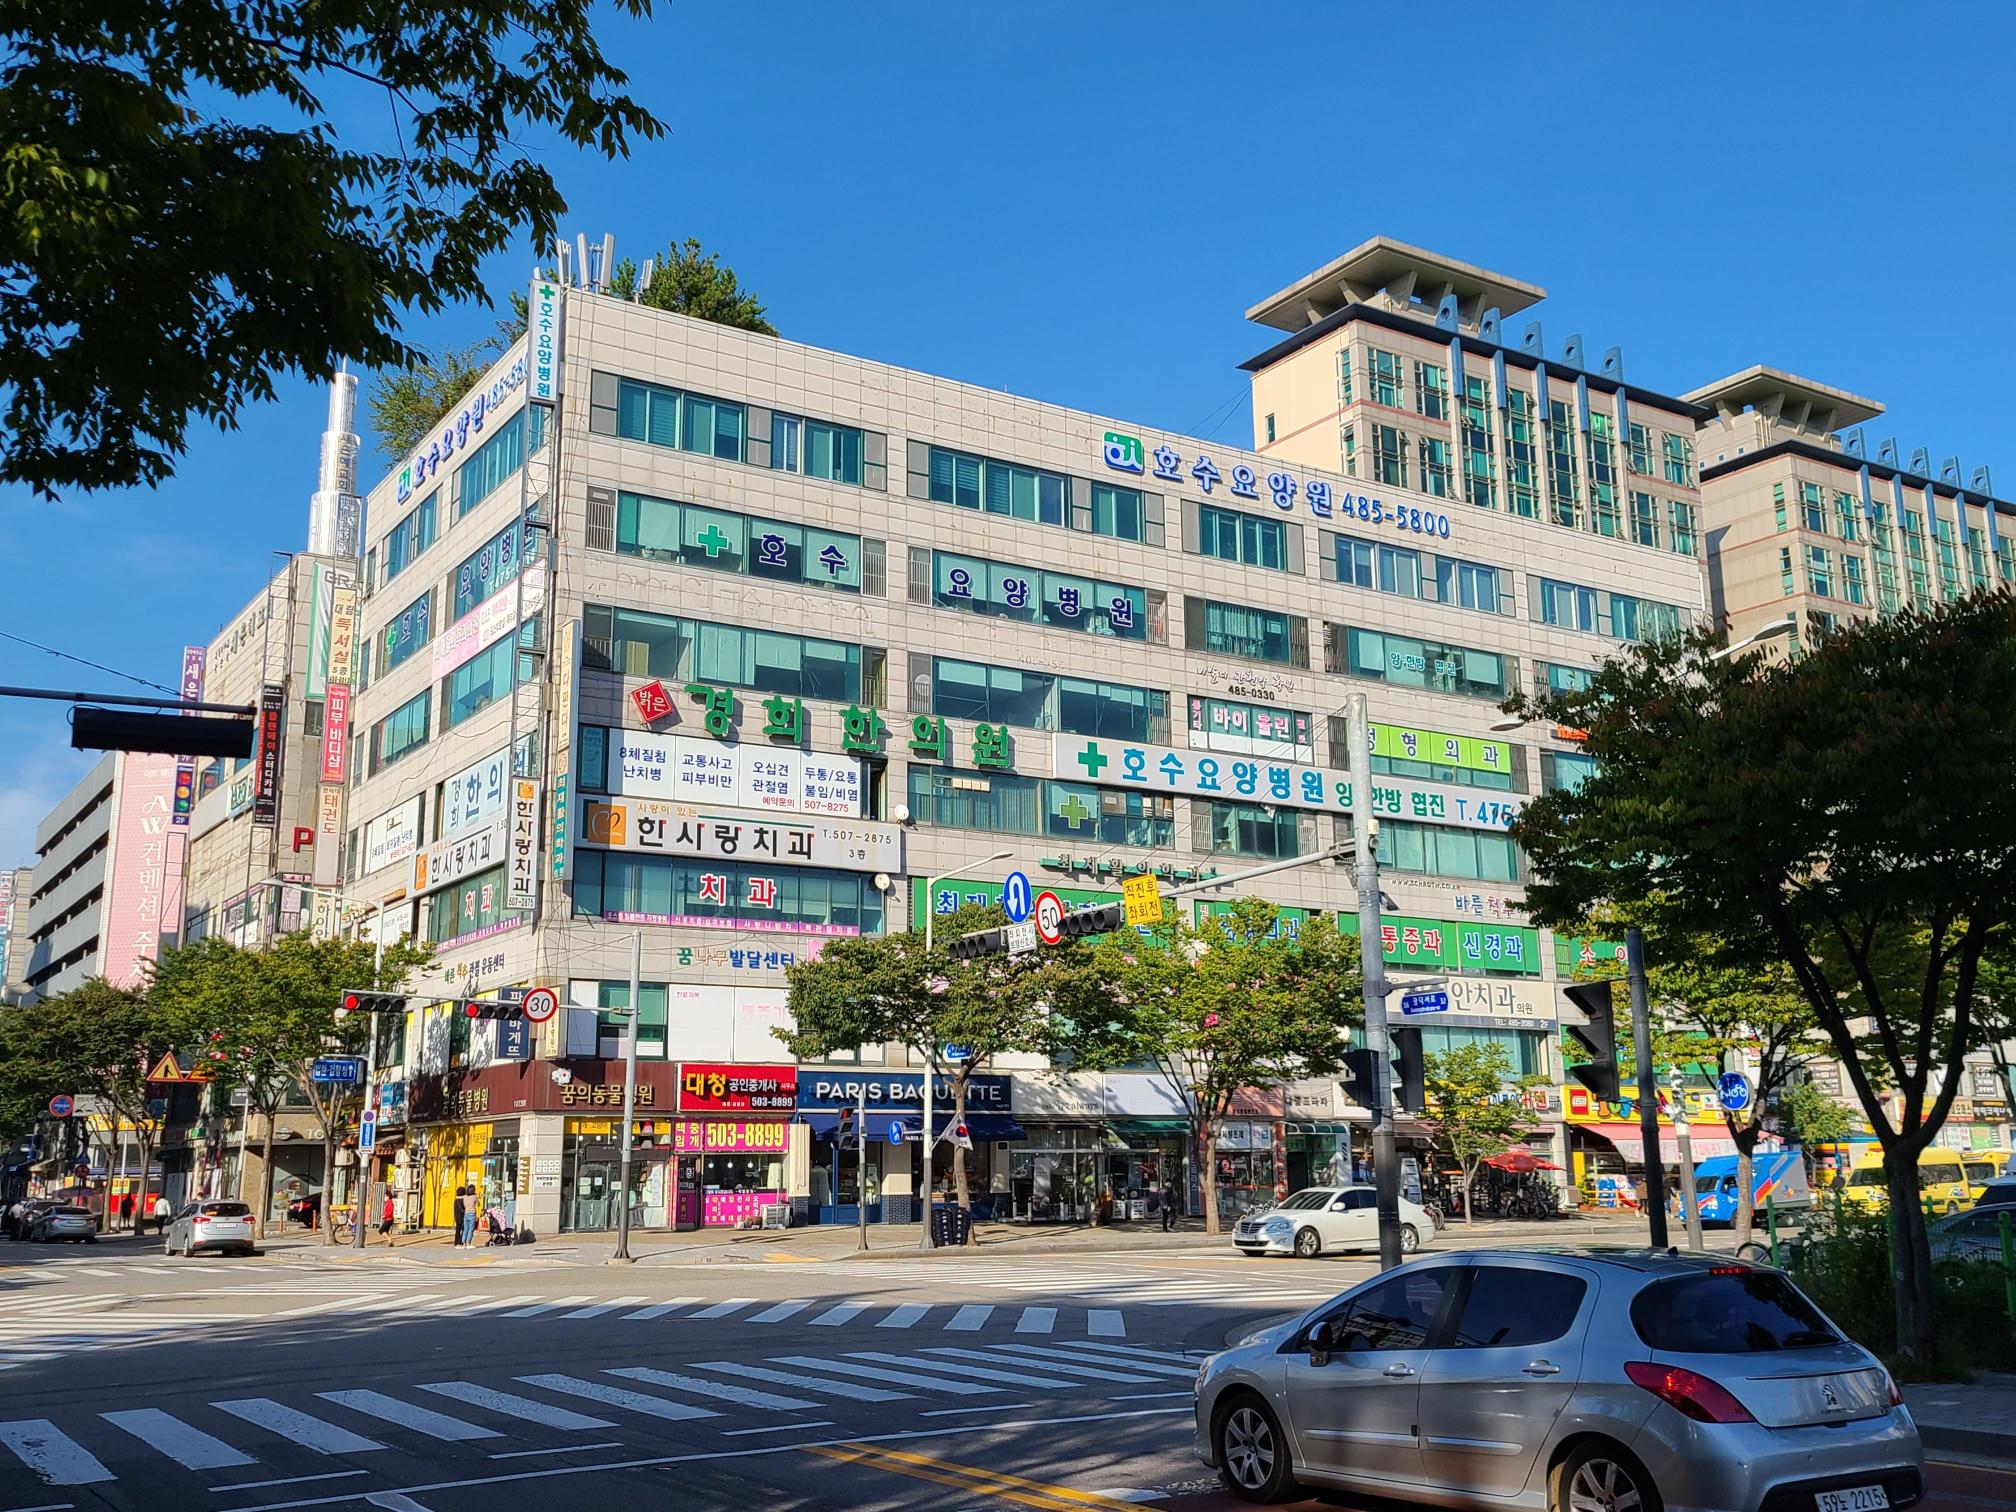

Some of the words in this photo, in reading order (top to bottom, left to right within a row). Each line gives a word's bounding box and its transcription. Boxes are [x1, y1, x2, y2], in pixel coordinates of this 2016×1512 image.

[537, 302, 554, 397] 호수요양병원
[413, 393, 485, 489] 호수요양원
[1153, 446, 1333, 518] 호수요양원
[1342, 492, 1450, 537] 485-5800
[948, 567, 1134, 627] 요양병원
[333, 618, 353, 663] 독서실
[1435, 659, 1457, 676] 협진
[1228, 685, 1276, 701] 485-0330
[330, 697, 345, 724] 피부
[1213, 707, 1290, 739] 바이올린
[684, 684, 1010, 769] 경희한의원
[327, 729, 344, 768] 바디샵
[619, 747, 667, 764] 8체질침
[263, 751, 275, 797] 스터디카페
[623, 765, 662, 782] 난치병
[682, 753, 734, 770] 교통사고
[752, 761, 790, 778] 오십견
[681, 771, 733, 790] 피부비만
[751, 778, 789, 795] 관절염
[804, 767, 858, 785] 두통/요통
[1122, 748, 1324, 806] 호수요양병원
[1411, 791, 1447, 819] 협진
[762, 796, 796, 809] 예약문의
[804, 785, 859, 802] 불임/비염
[322, 794, 338, 835] 태권도
[804, 800, 850, 814] 507-8275
[293, 826, 315, 853] P
[514, 800, 533, 894] 한사랑치과
[638, 816, 816, 861] 한사랑치과
[822, 828, 893, 846] T.507-2875
[431, 832, 493, 884] 한사랑치과
[848, 848, 867, 861] 3층
[464, 883, 494, 921] 치과
[508, 896, 535, 908] 507-2875
[700, 873, 778, 909] 치과
[1128, 901, 1159, 921] 좌회전
[1454, 893, 1484, 916] 바른
[1042, 905, 1059, 930] 50
[677, 945, 795, 970] 꿈나무발달센터
[1464, 932, 1523, 962] 신경과
[530, 997, 551, 1013] 30
[1451, 981, 1517, 1014] 안치과
[1516, 1002, 1534, 1015] 의원
[506, 991, 524, 1056] 파바게뜨
[686, 1073, 726, 1097] 대청
[729, 1078, 778, 1092] 공인중개사
[816, 1081, 883, 1100] PARIS
[751, 1096, 793, 1107] 503-8899
[706, 1122, 784, 1148] 503-8899
[1823, 1493, 1849, 1512] 59노
[1850, 1488, 1883, 1510] 2215
